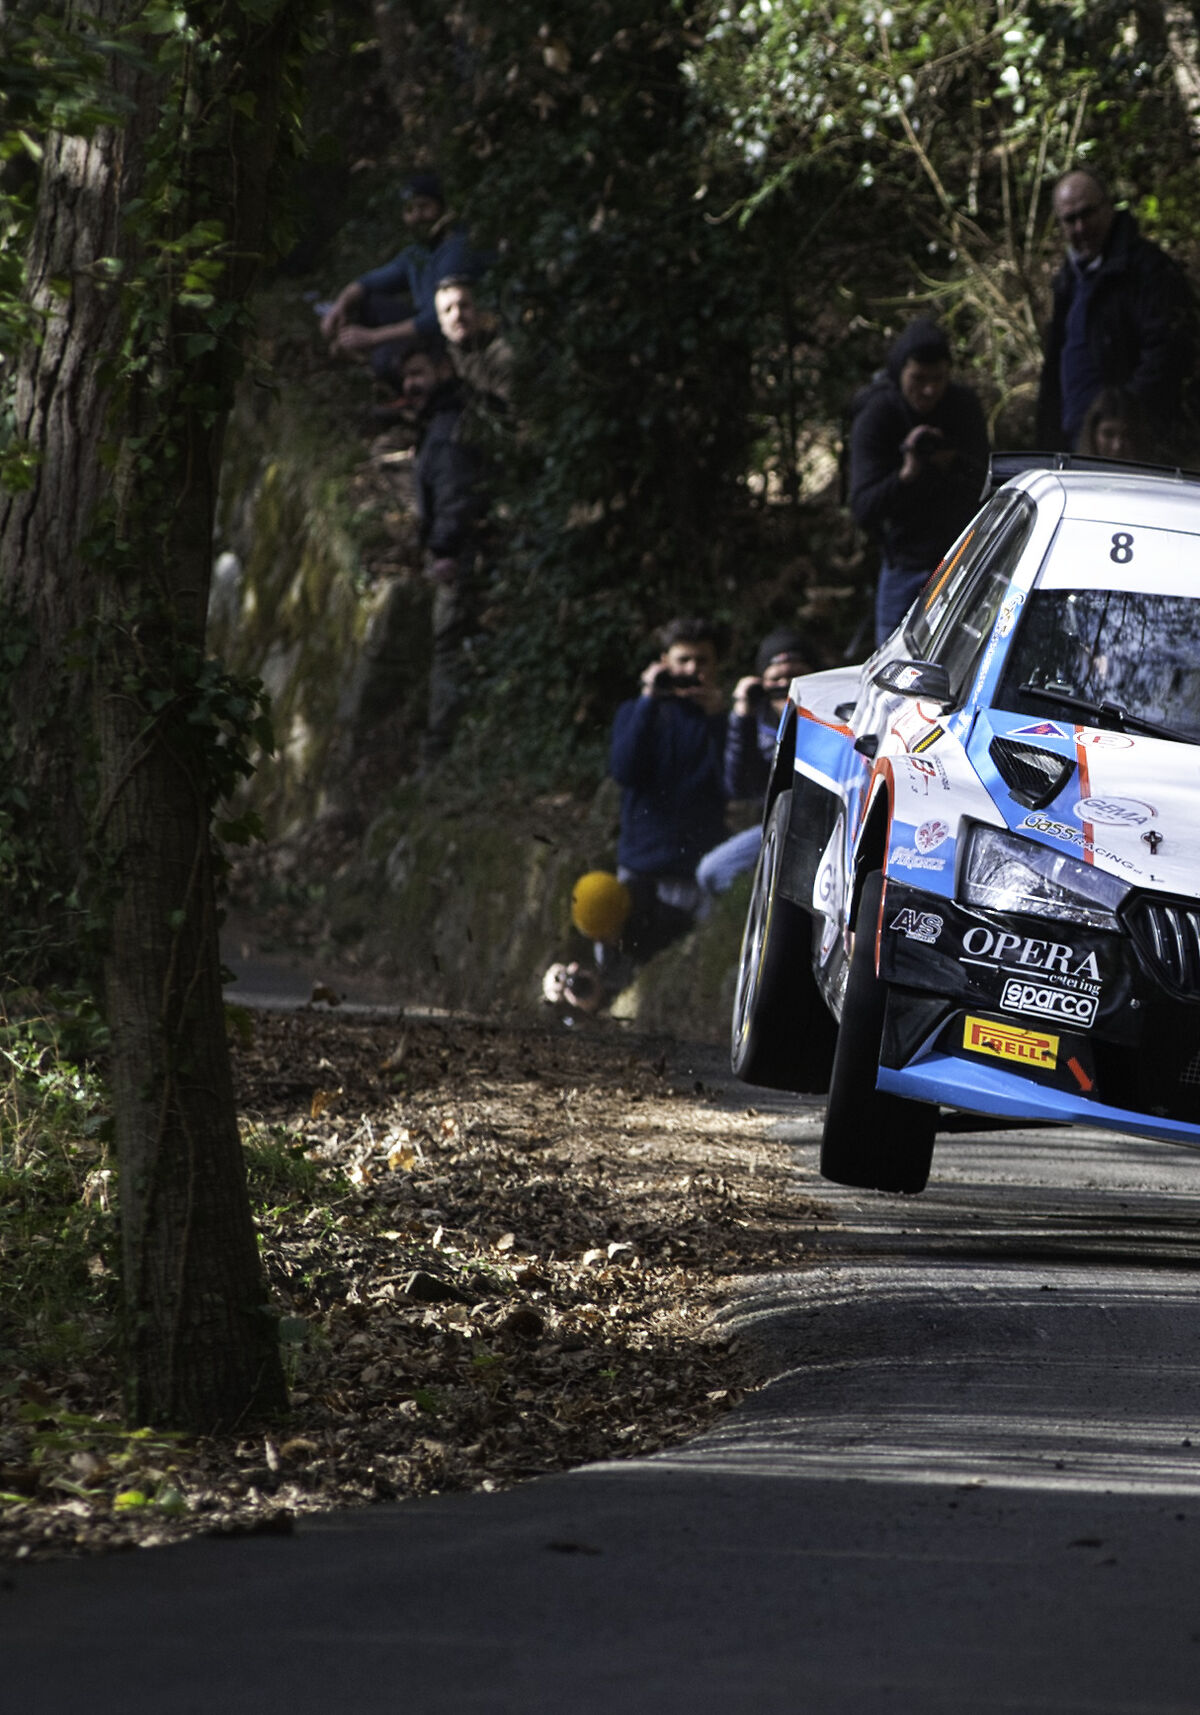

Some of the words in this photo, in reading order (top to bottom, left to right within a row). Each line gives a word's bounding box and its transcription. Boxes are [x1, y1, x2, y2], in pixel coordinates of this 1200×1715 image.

[1110, 532, 1134, 564] 8
[1084, 799, 1148, 825] GEMA
[890, 908, 943, 937] AVS
[962, 927, 1103, 982] OPERA
[1007, 983, 1093, 1017] sparco
[1049, 974, 1102, 996] catering
